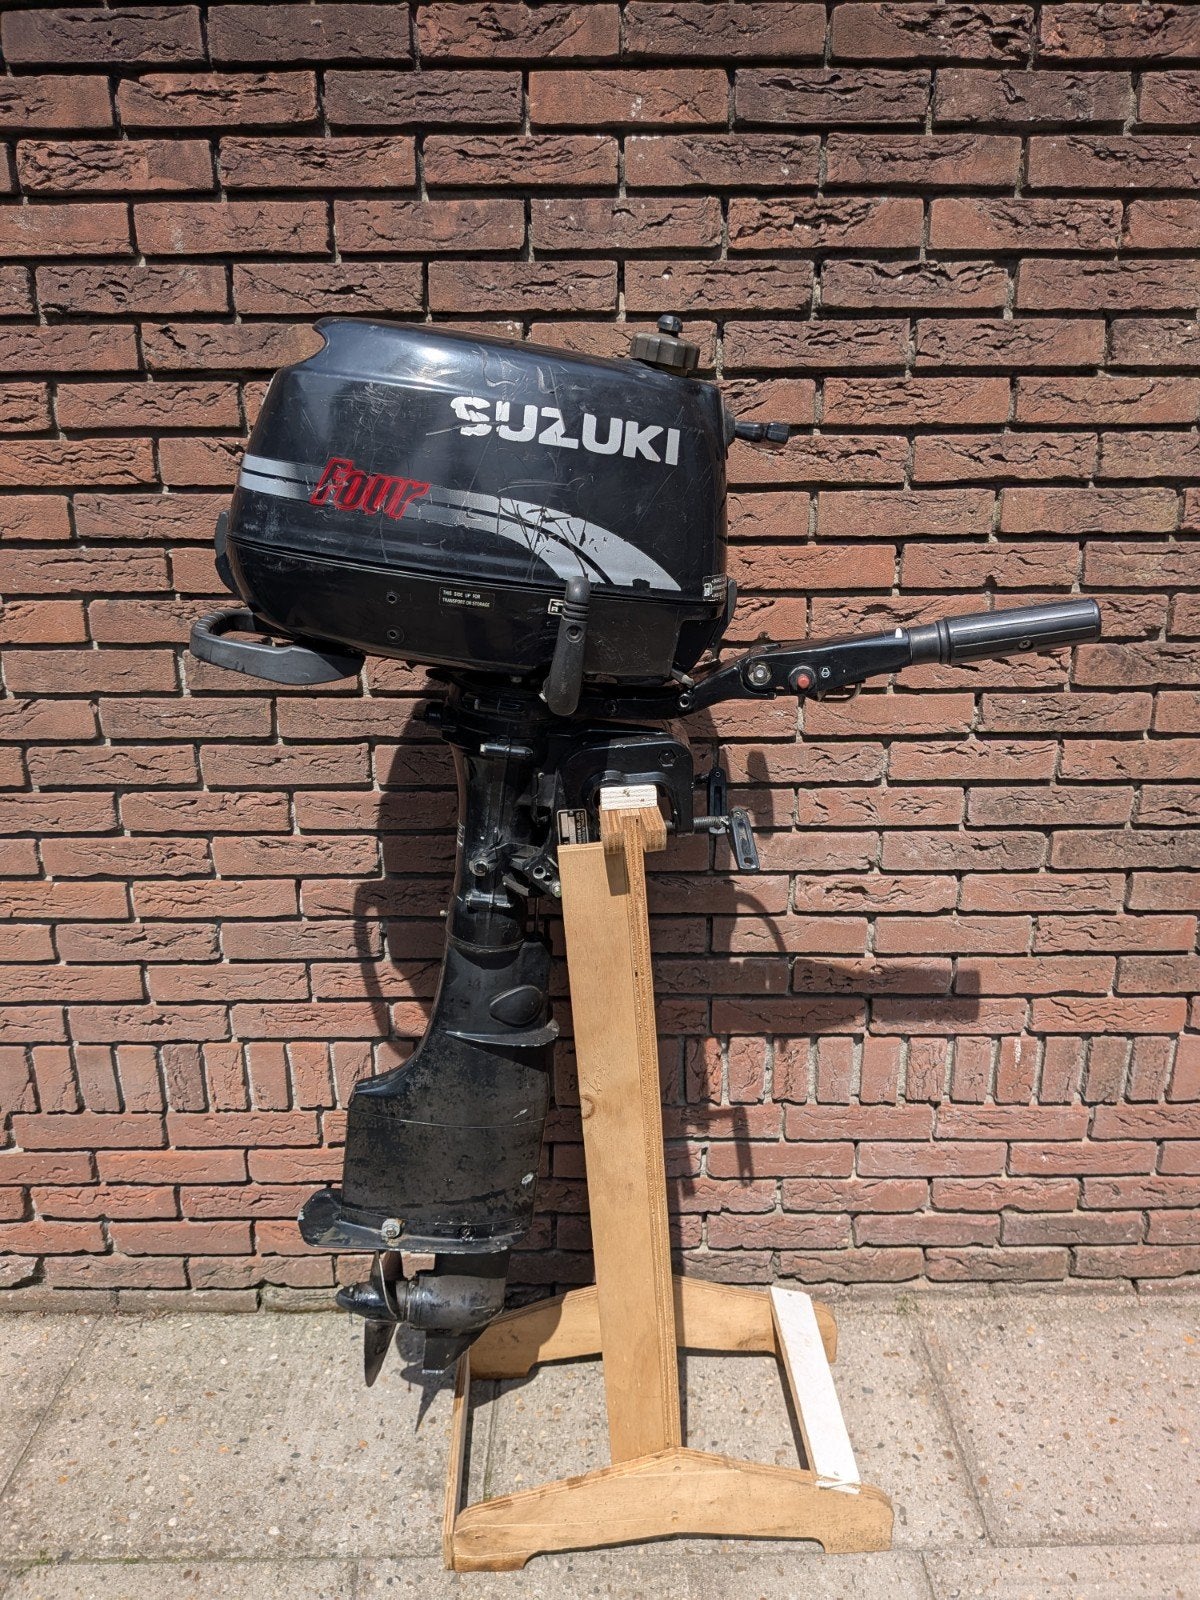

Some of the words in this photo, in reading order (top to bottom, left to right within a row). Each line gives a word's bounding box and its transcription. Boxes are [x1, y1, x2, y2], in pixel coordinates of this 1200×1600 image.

[450, 396, 681, 466] SUZUKI
[309, 456, 431, 520] Four
[442, 597, 466, 605] TRANSPORT
